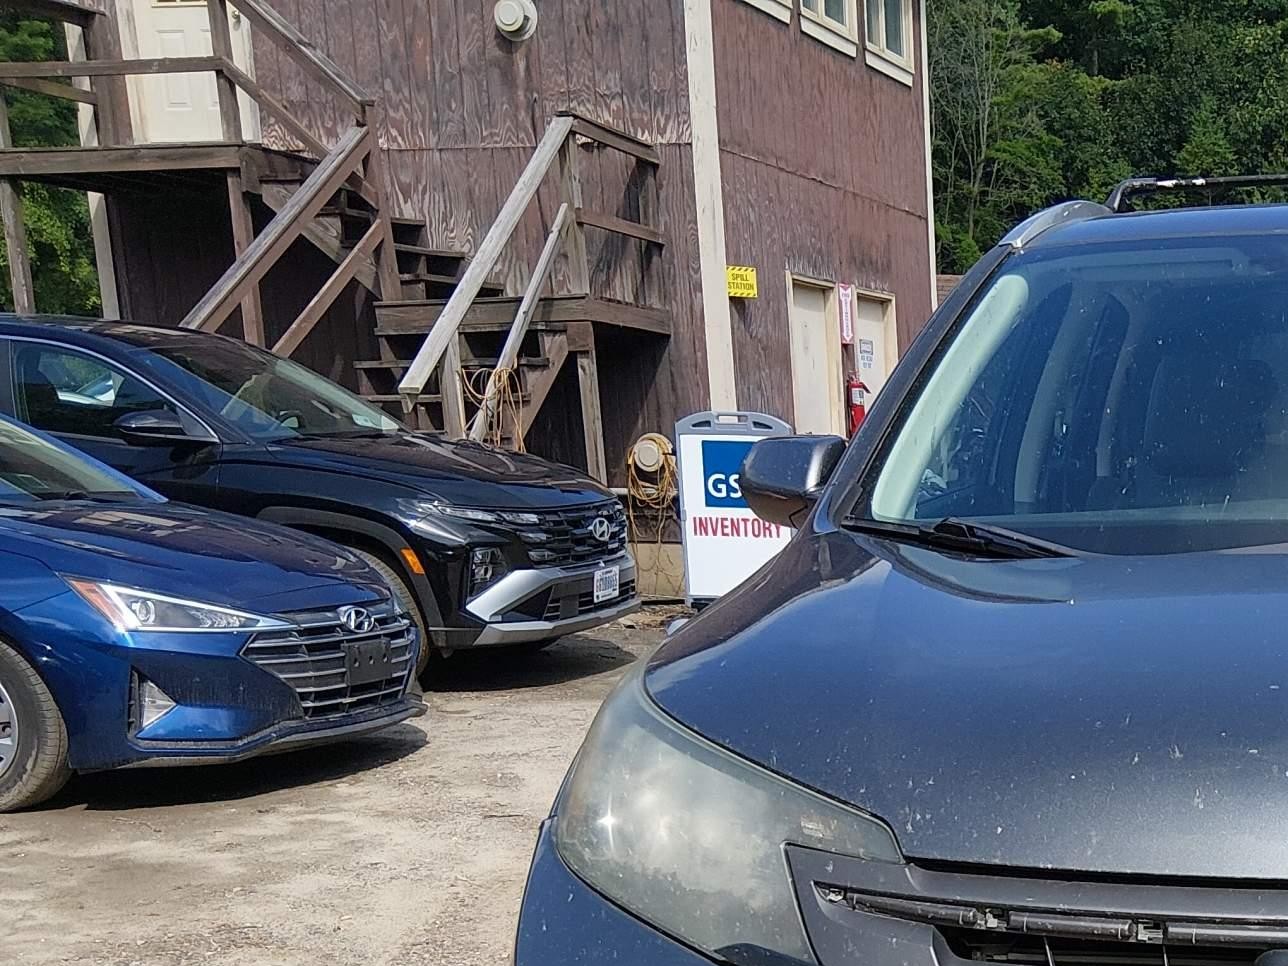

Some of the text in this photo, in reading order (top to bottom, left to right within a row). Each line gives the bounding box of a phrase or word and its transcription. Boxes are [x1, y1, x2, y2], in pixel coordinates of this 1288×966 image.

[731, 273, 749, 281] SPILL
[728, 282, 754, 290] STATION
[692, 516, 781, 538] INVENTORY
